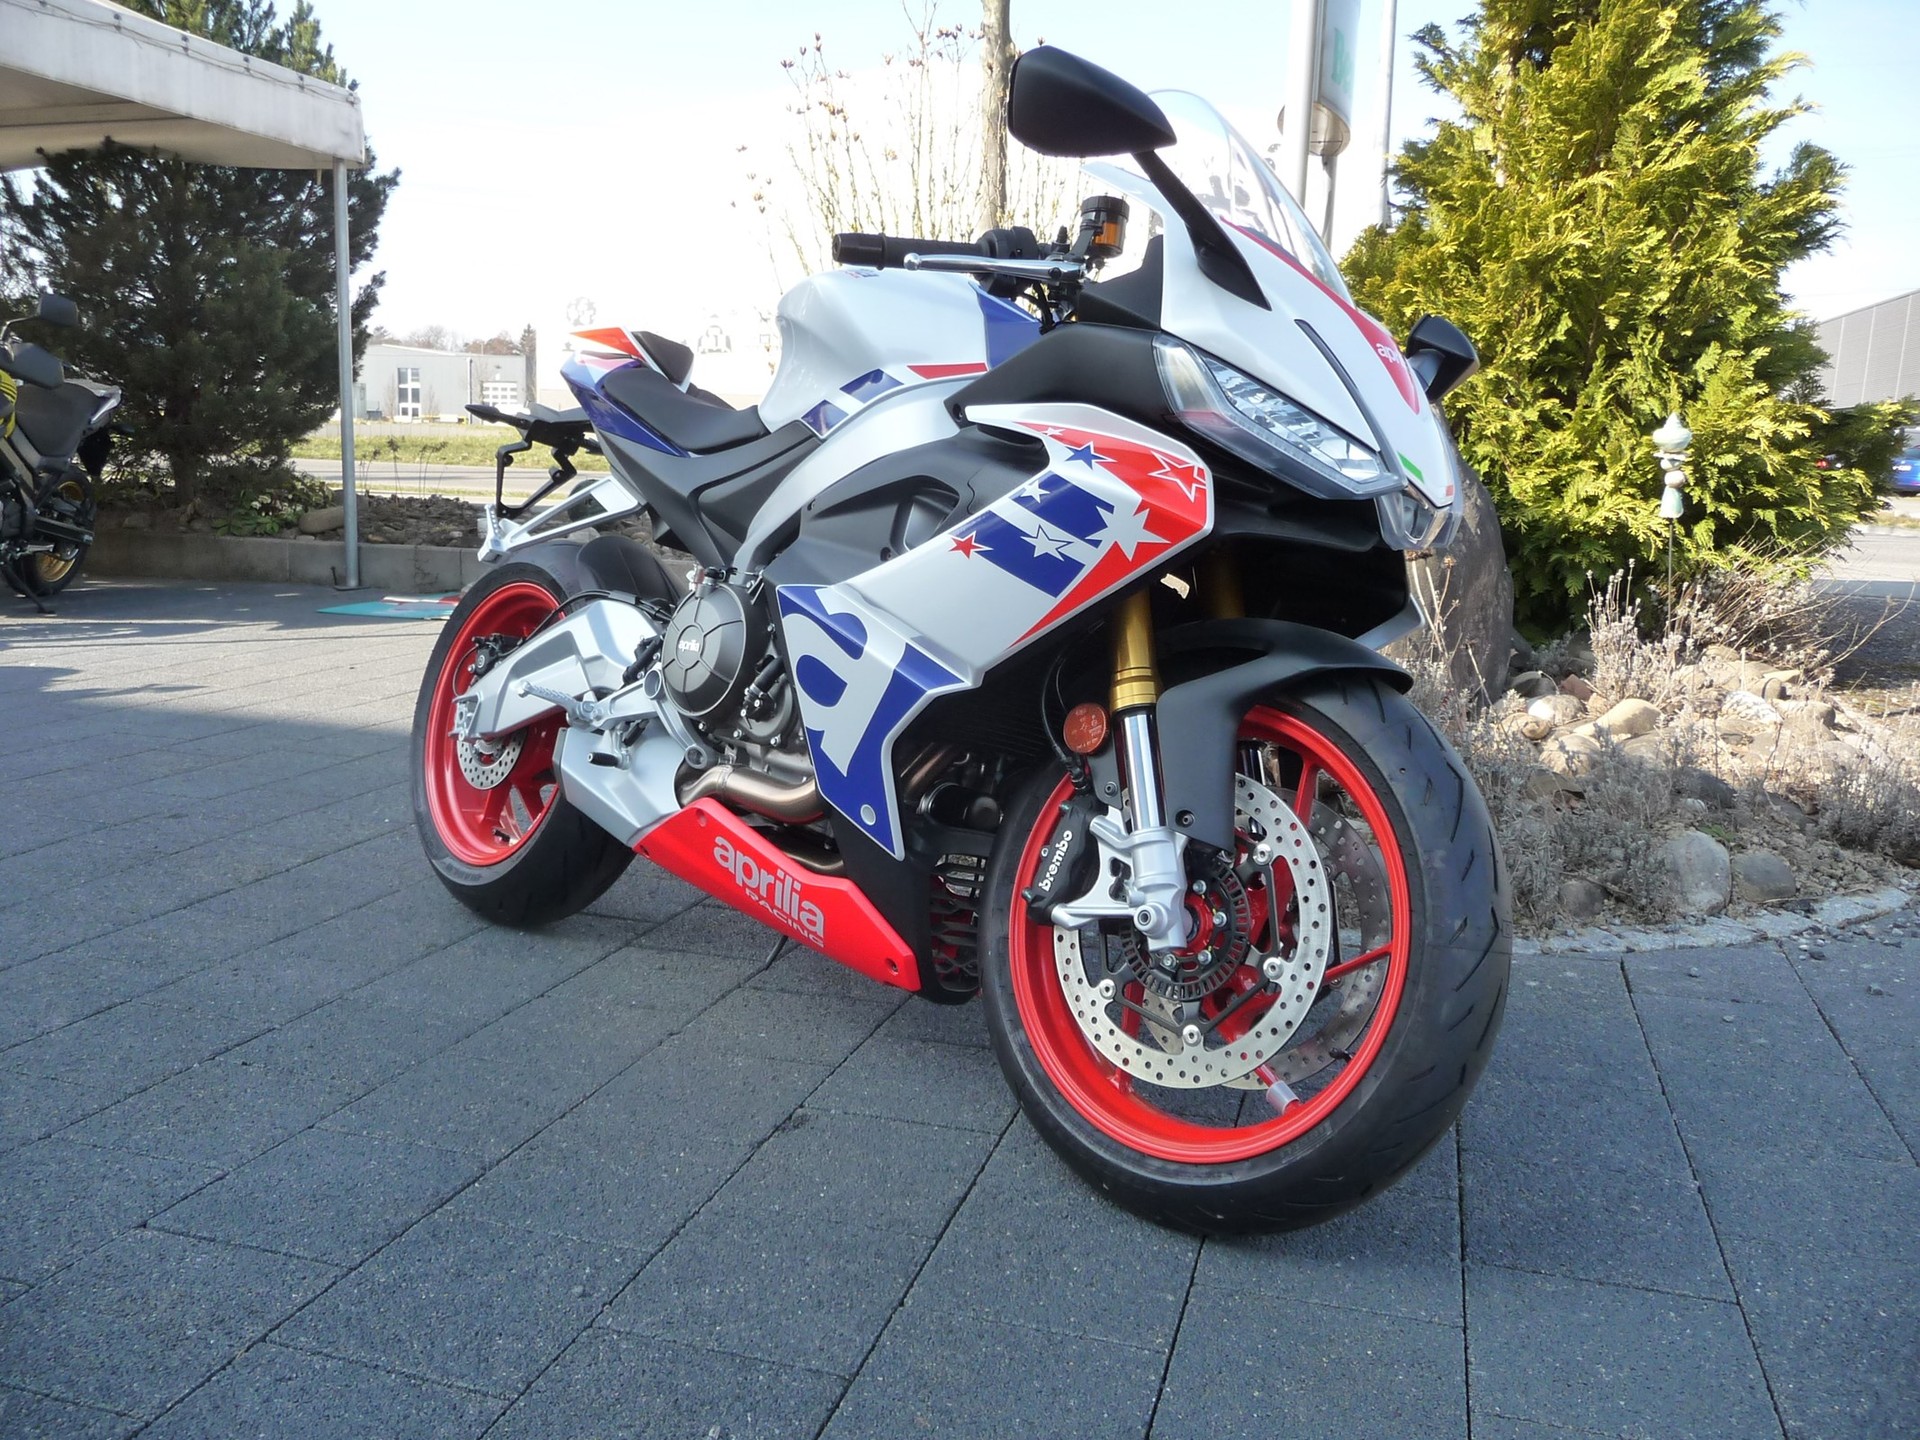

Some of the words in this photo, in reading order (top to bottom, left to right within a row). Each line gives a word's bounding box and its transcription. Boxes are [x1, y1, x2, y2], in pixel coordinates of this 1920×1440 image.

[713, 836, 824, 938] aprilia
[1038, 830, 1073, 892] brembo
[745, 887, 824, 948] RACING
